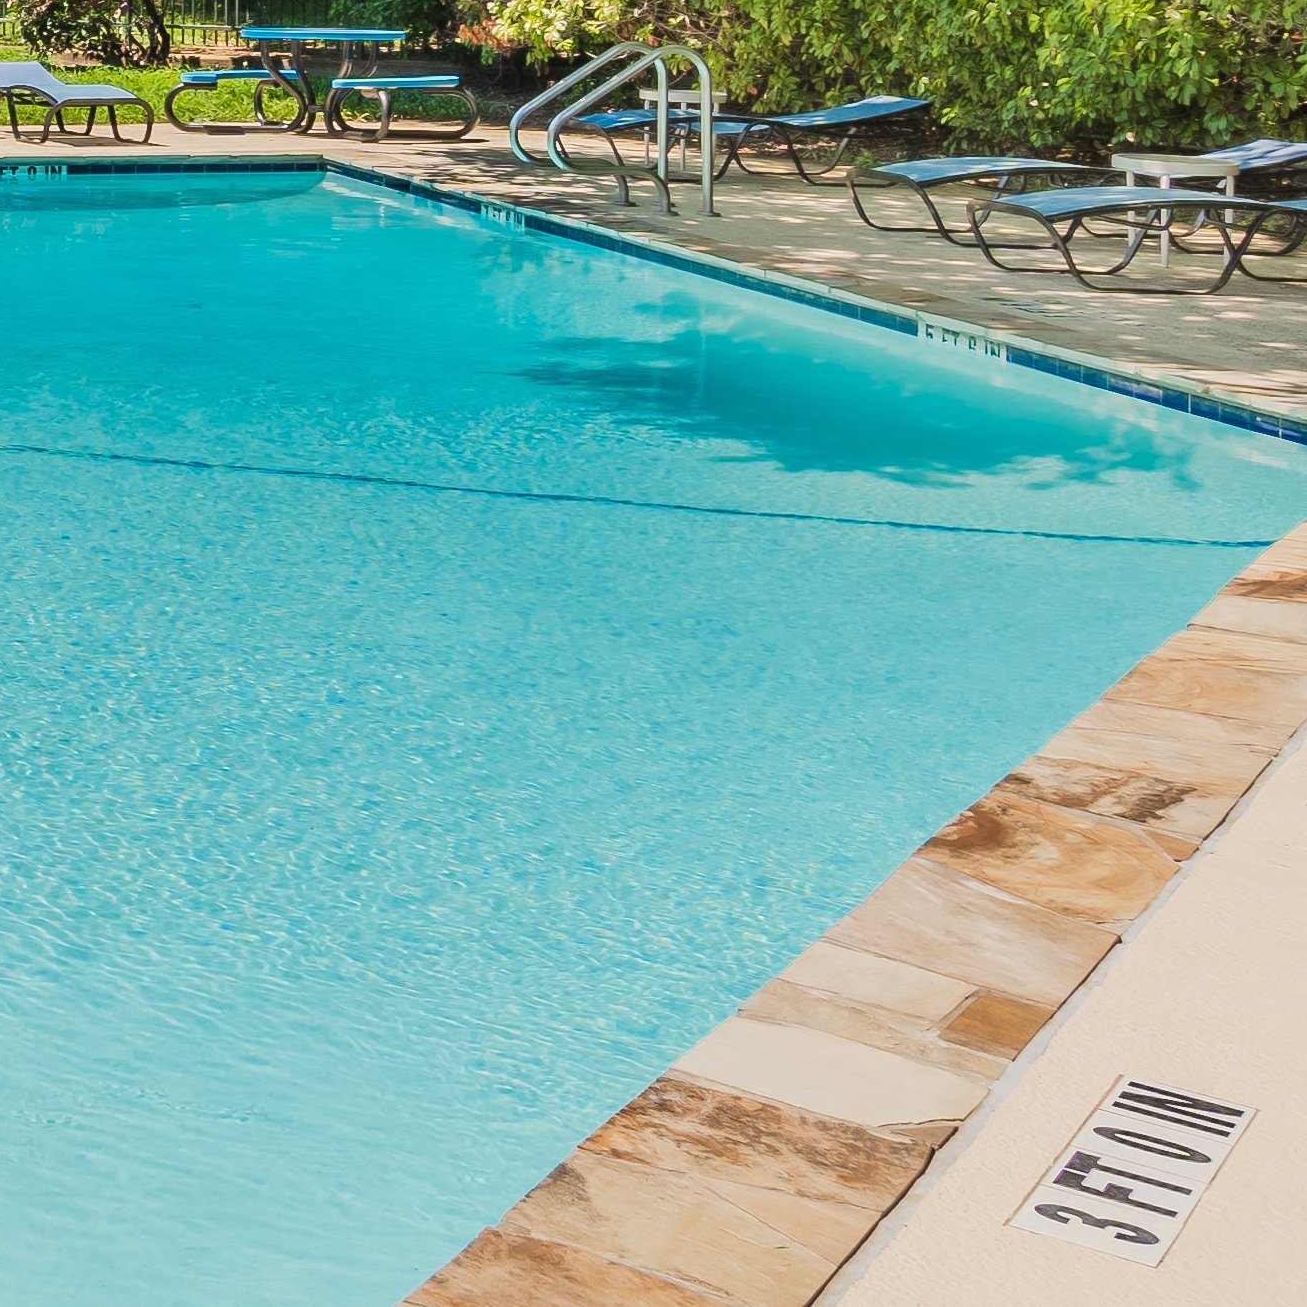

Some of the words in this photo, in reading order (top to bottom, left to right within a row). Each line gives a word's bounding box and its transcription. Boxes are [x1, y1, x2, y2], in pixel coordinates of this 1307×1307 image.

[45, 165, 62, 175] IN
[1111, 1080, 1245, 1138] IN
[1051, 1150, 1193, 1218] FT
[1034, 1203, 1160, 1245] 3
